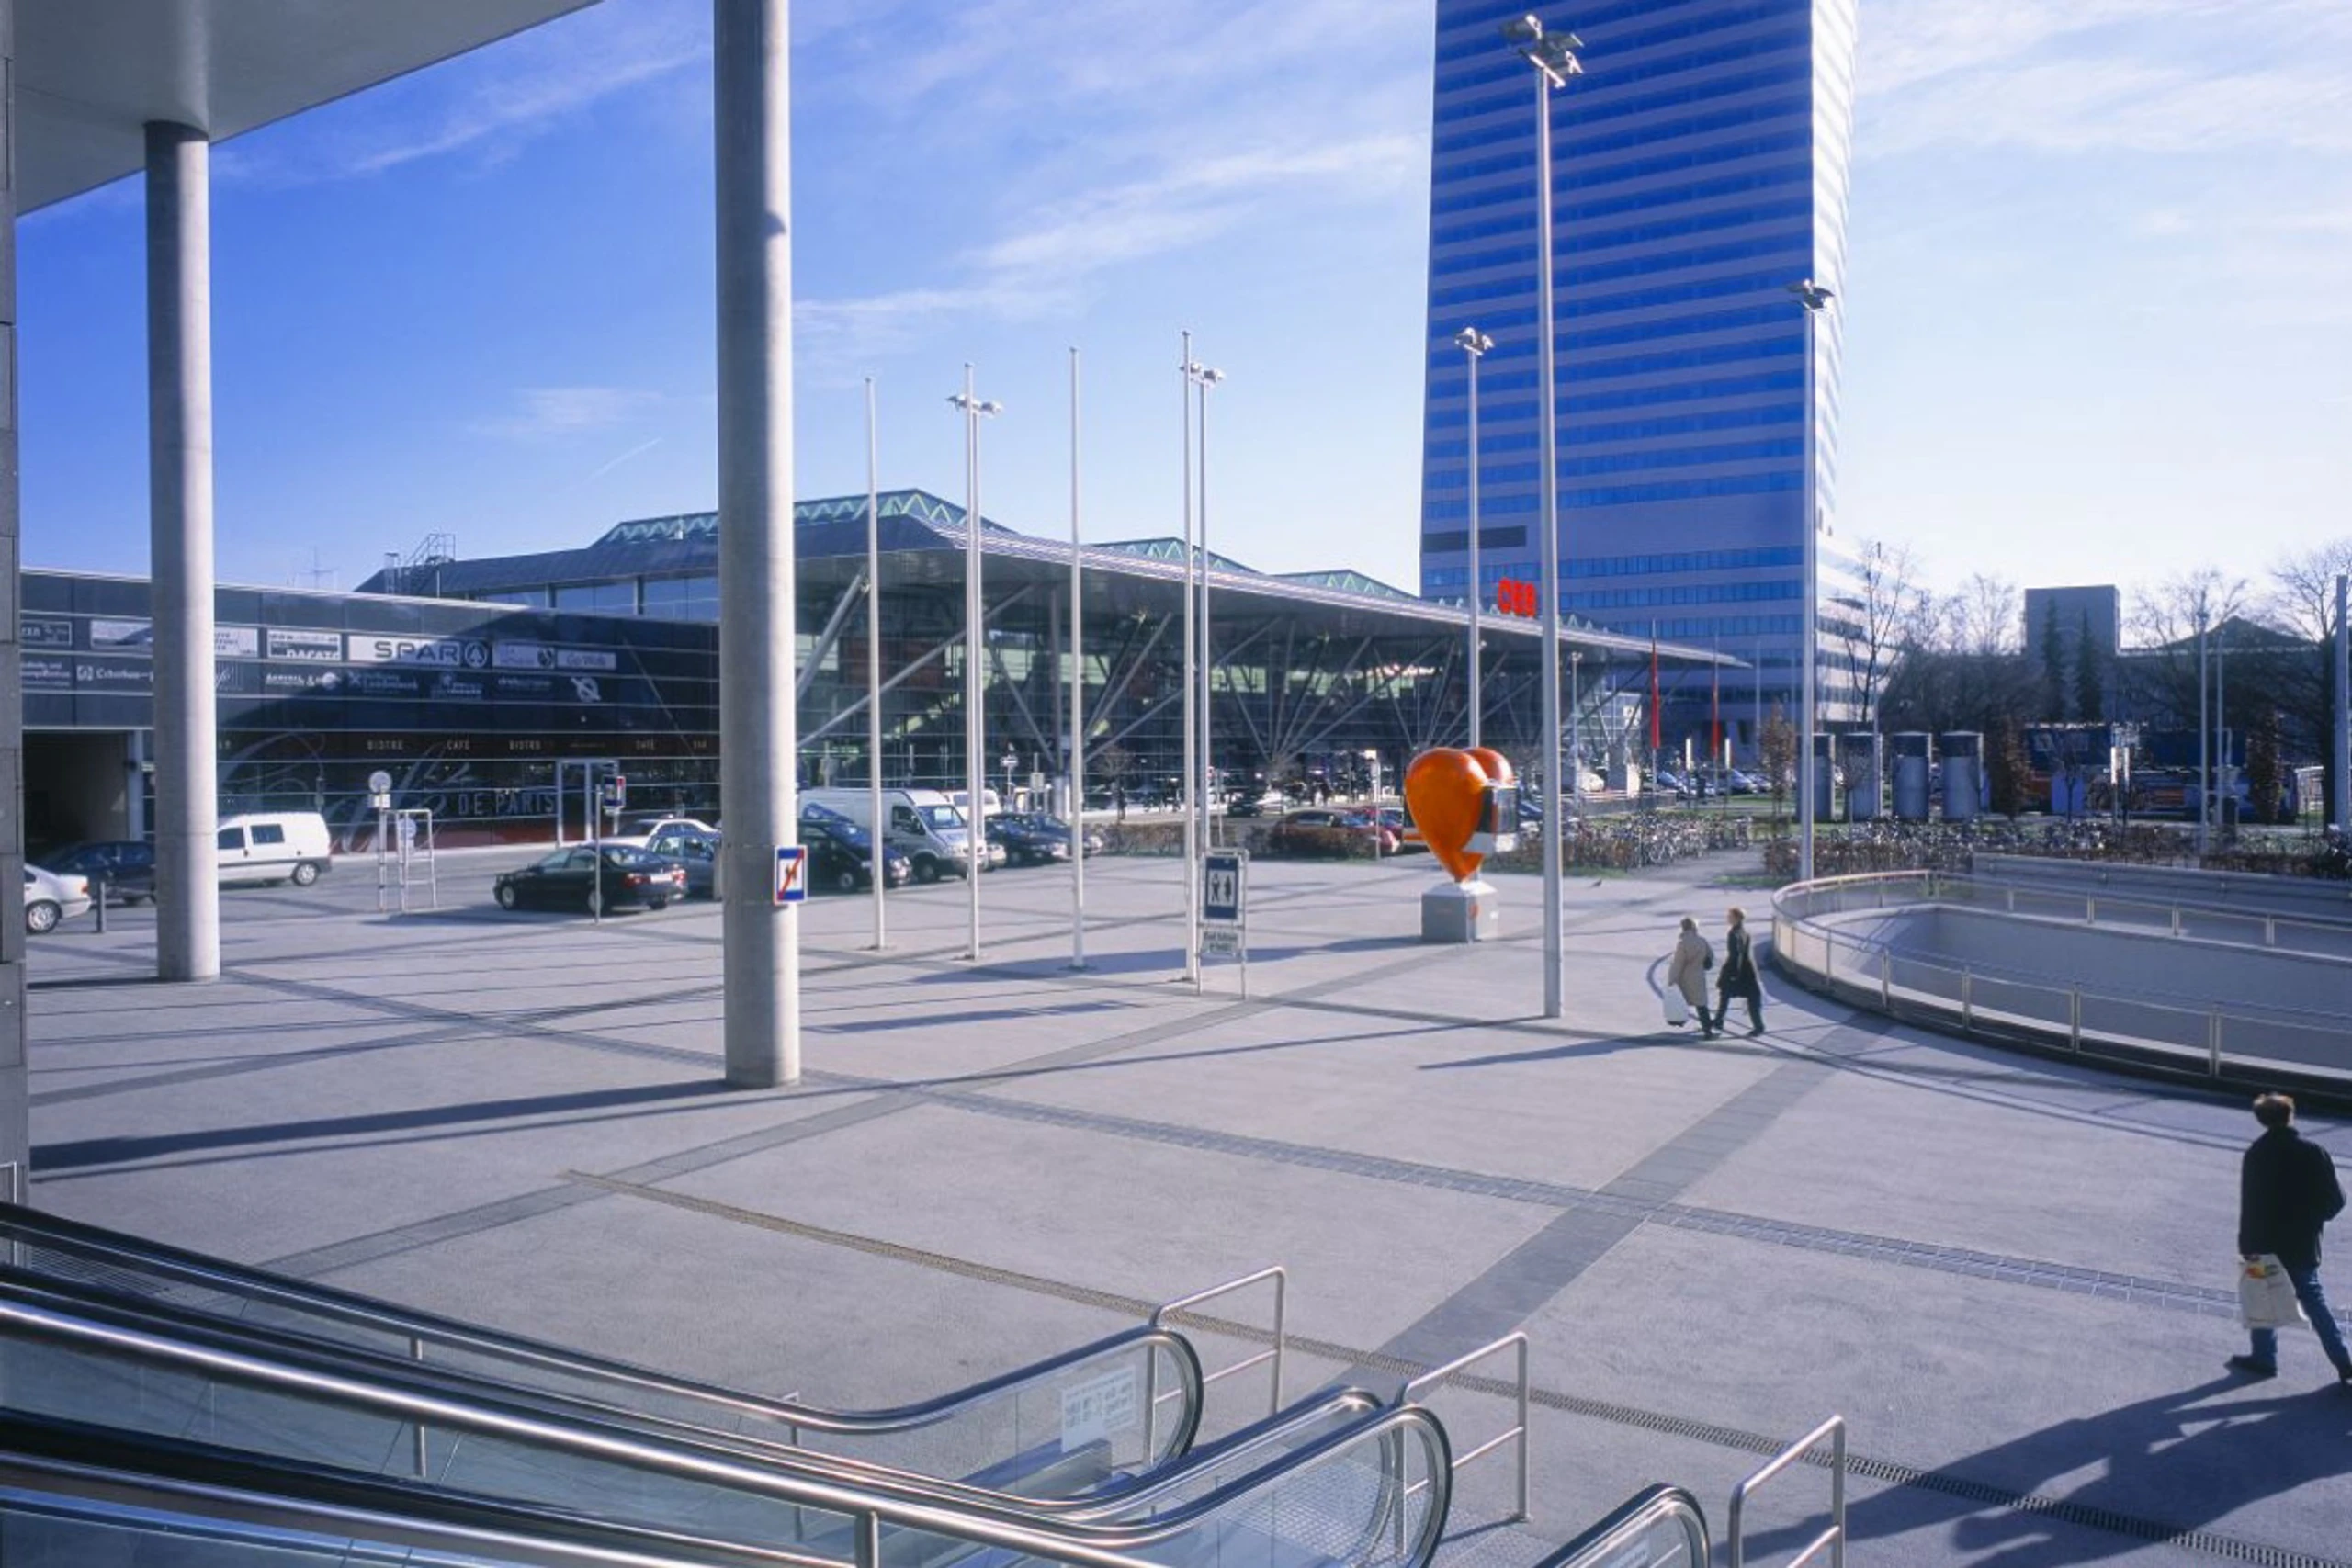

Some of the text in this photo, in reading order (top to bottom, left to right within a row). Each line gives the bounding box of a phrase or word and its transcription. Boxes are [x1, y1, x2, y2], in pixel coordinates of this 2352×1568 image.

[374, 640, 458, 661] SPAR
[458, 793, 484, 815] DE
[496, 791, 554, 814] PARIS
